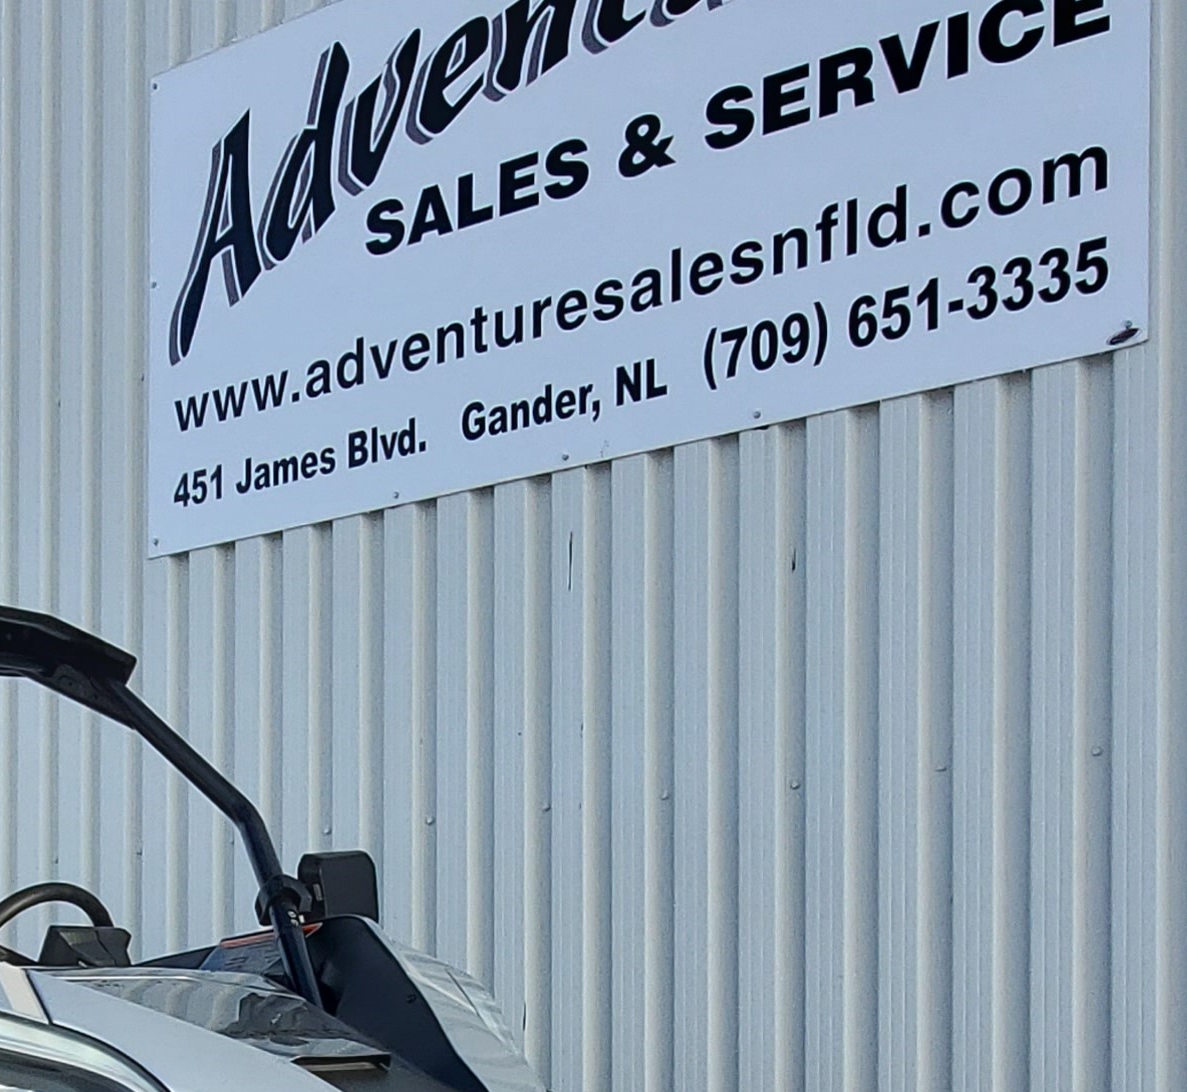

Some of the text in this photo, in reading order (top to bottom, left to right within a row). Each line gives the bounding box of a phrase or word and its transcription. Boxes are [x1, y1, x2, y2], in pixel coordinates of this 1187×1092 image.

[365, 0, 1110, 256] SALES & SERVICE
[173, 236, 1108, 507] 451 James Blvd. Gander, NL (709) 651-3335
[174, 146, 1108, 432] www.adventuresalesnfld.com
